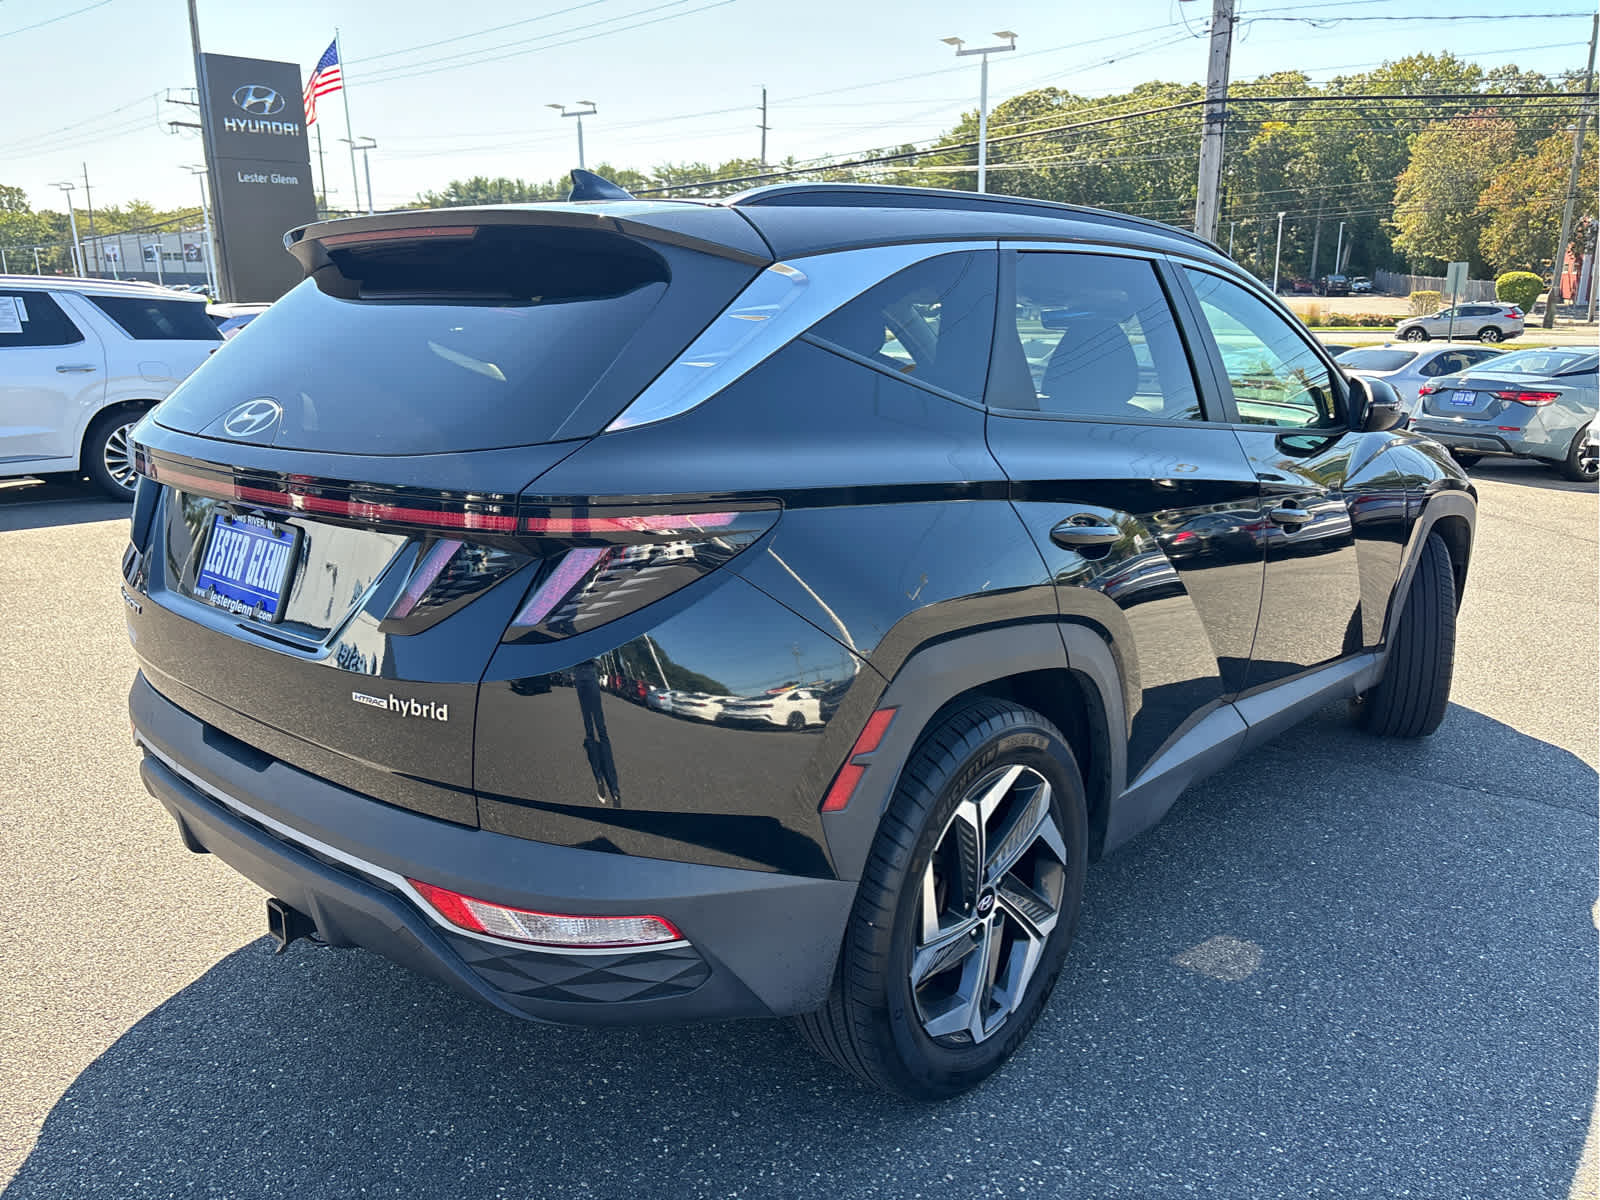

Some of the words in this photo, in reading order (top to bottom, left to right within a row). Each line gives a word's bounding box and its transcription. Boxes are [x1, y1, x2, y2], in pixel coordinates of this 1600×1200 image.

[224, 117, 299, 136] HYUNDAI
[237, 171, 268, 183] Lester
[270, 173, 299, 185] Glenn
[204, 527, 250, 581] LESTER
[245, 539, 290, 594] GLENN
[389, 693, 448, 721] hybrid
